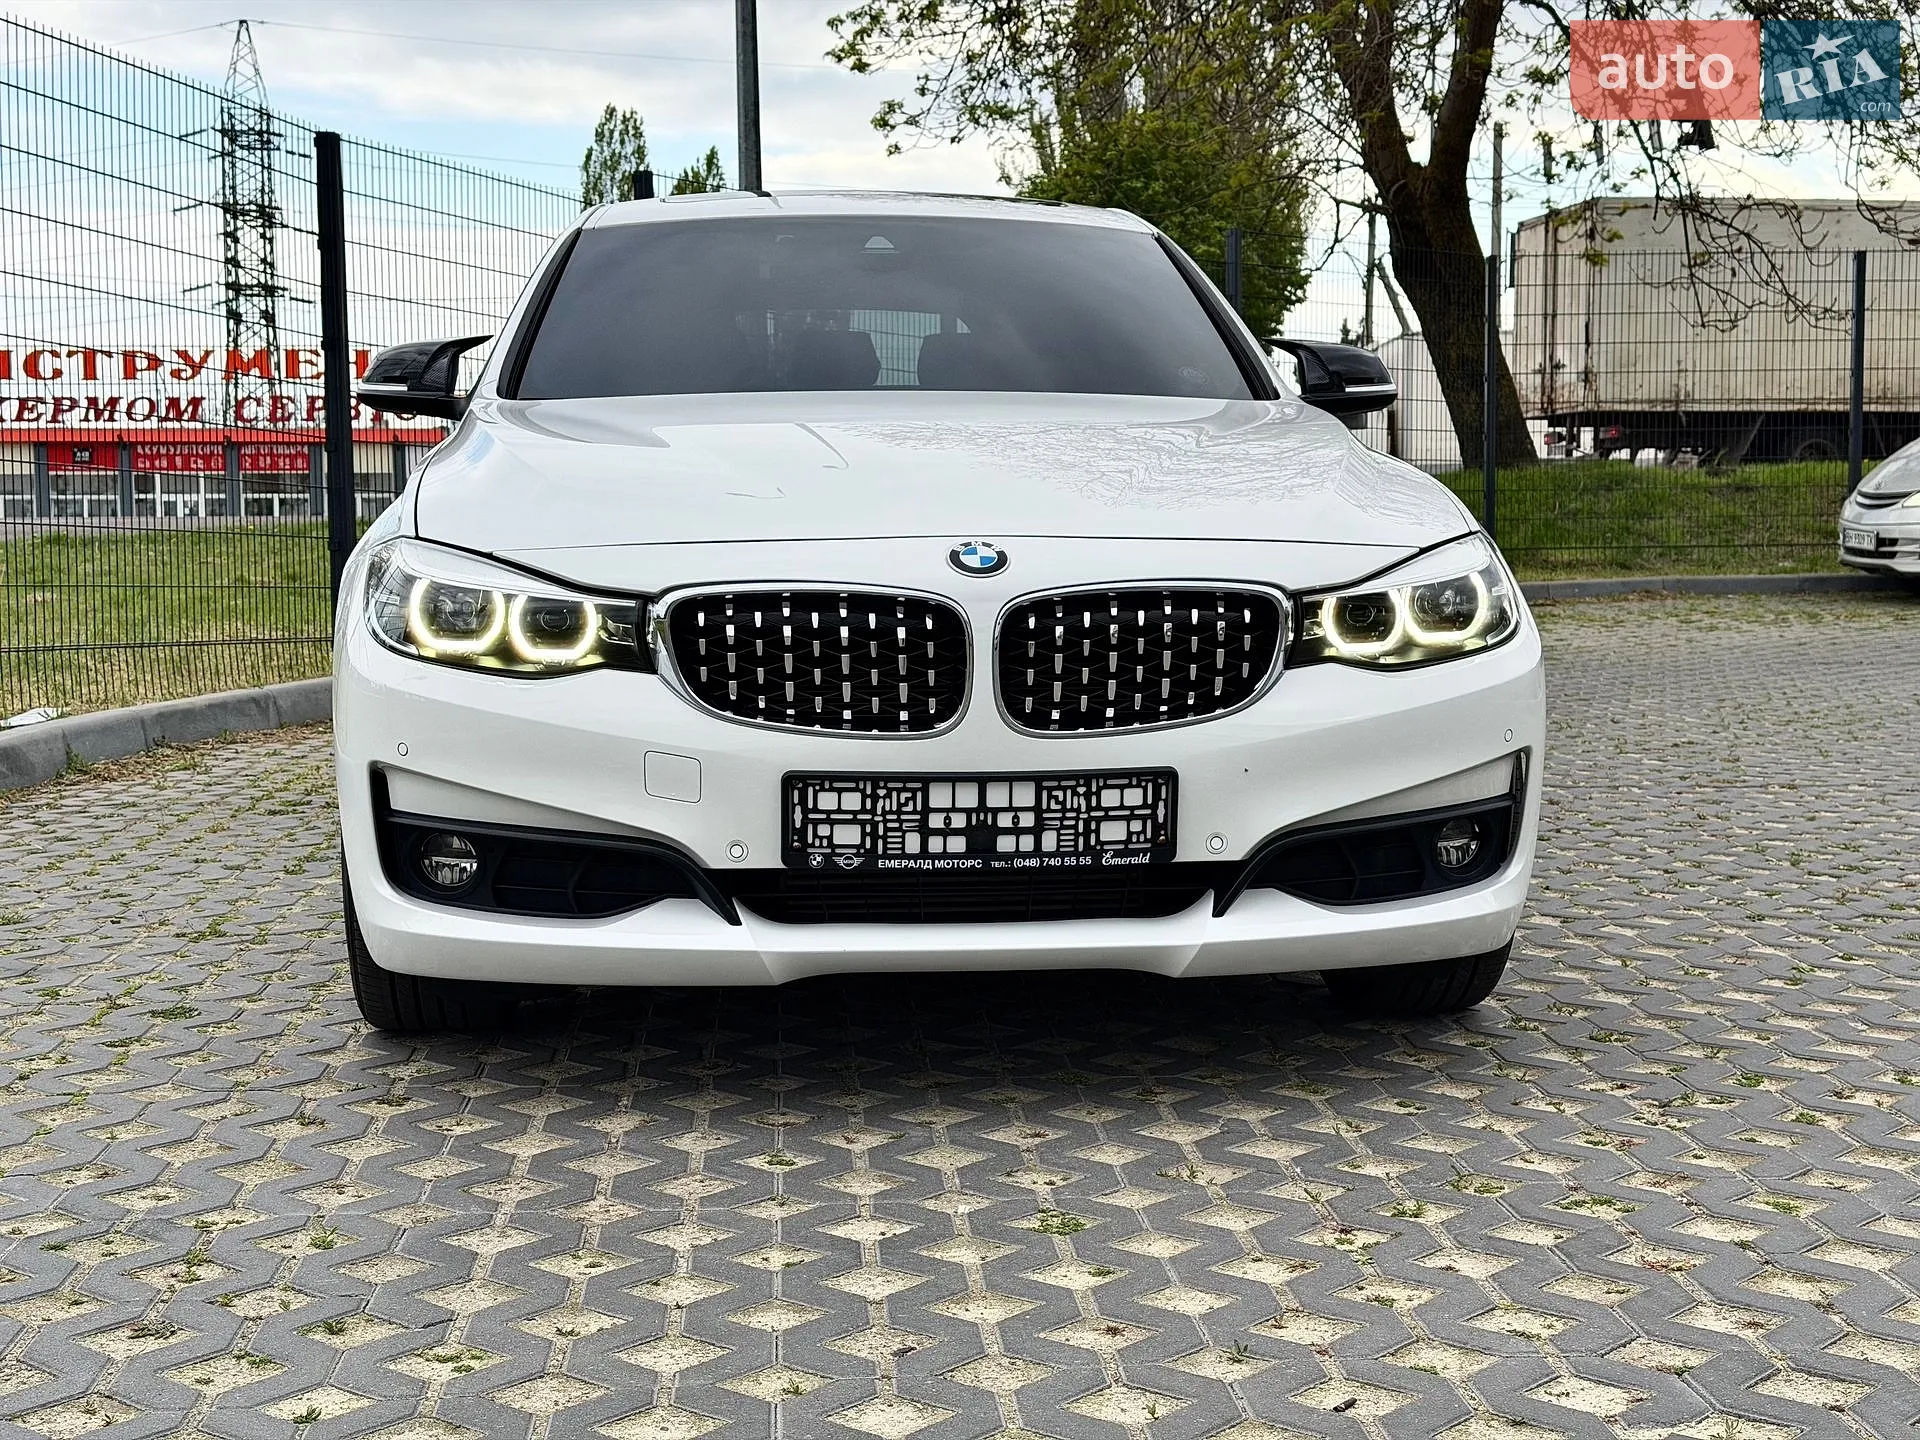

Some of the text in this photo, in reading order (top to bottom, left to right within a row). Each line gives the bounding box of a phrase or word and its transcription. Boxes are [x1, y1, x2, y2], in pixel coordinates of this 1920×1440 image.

[878, 859, 933, 869] ЕМЕРАЛД
[934, 859, 983, 868] МОТОРС
[1013, 857, 1040, 868] (048)
[1042, 857, 1061, 867] 740
[1063, 856, 1077, 866] 55
[1079, 856, 1092, 865] 55
[1101, 851, 1151, 866] Emerald
